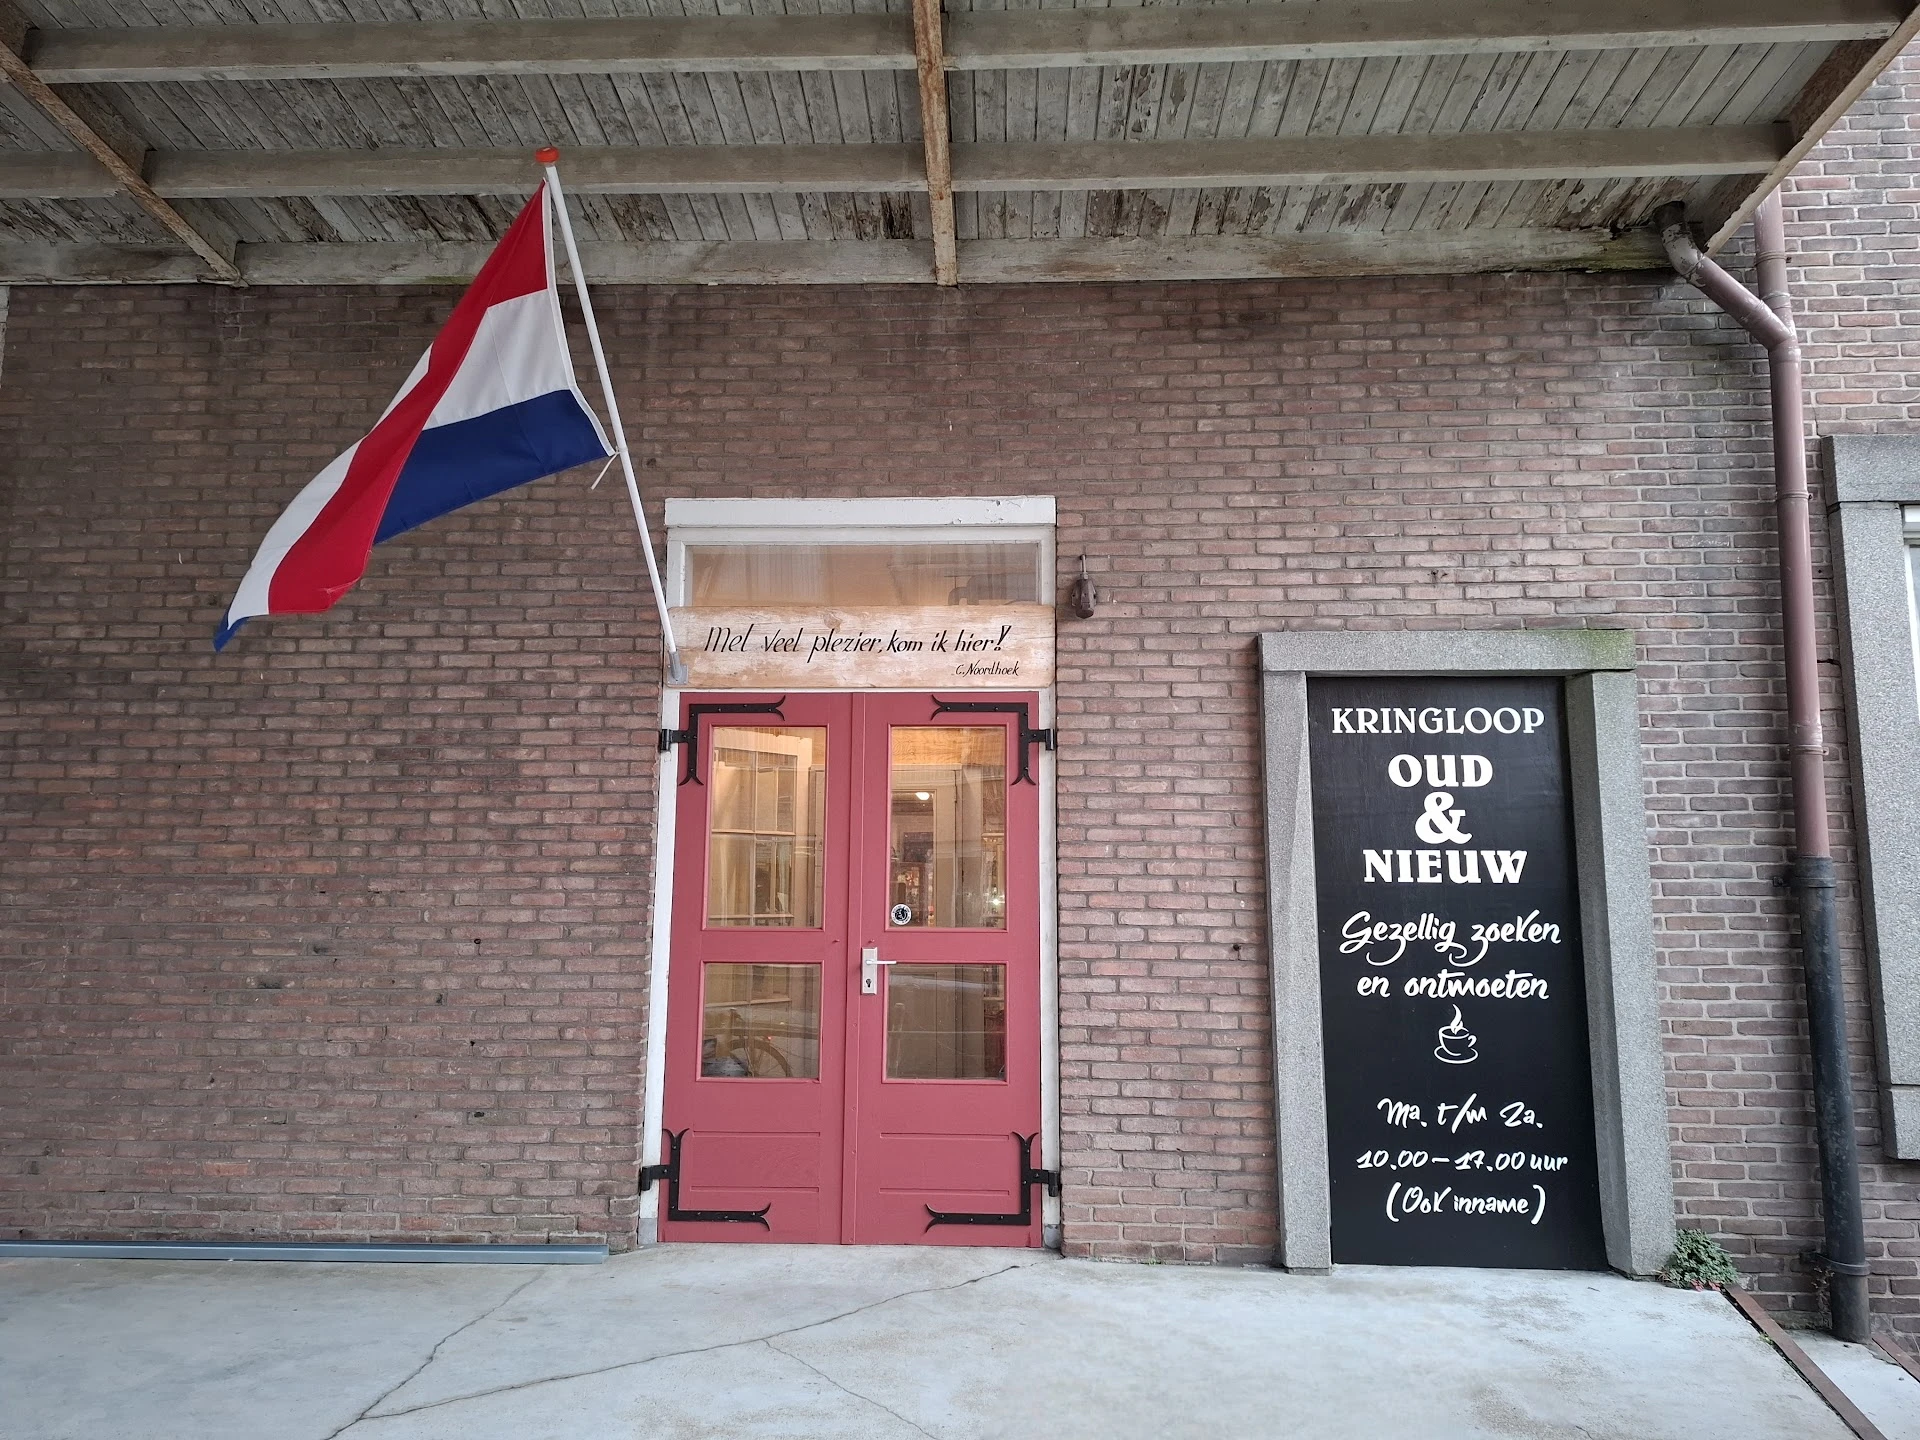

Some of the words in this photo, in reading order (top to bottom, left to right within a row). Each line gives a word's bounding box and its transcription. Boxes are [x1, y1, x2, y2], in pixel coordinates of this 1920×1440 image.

[764, 628, 804, 653] veel
[931, 629, 948, 653] ik
[954, 624, 1012, 652] hier!
[1331, 706, 1545, 735] KRINGLOOP
[1387, 753, 1494, 788] OUD
[1414, 791, 1473, 845] &
[1362, 849, 1528, 884] NIEUW
[1338, 910, 1468, 967] Gezellig
[1356, 975, 1391, 998] en
[1403, 968, 1550, 1000] ontmoeten
[1376, 1097, 1428, 1129] Ma.
[1437, 1092, 1488, 1134] t/m
[1499, 1101, 1543, 1129] Za.
[1529, 1153, 1569, 1172] uur
[1385, 1181, 1452, 1223] (Ook
[1453, 1184, 1546, 1225] inname)
